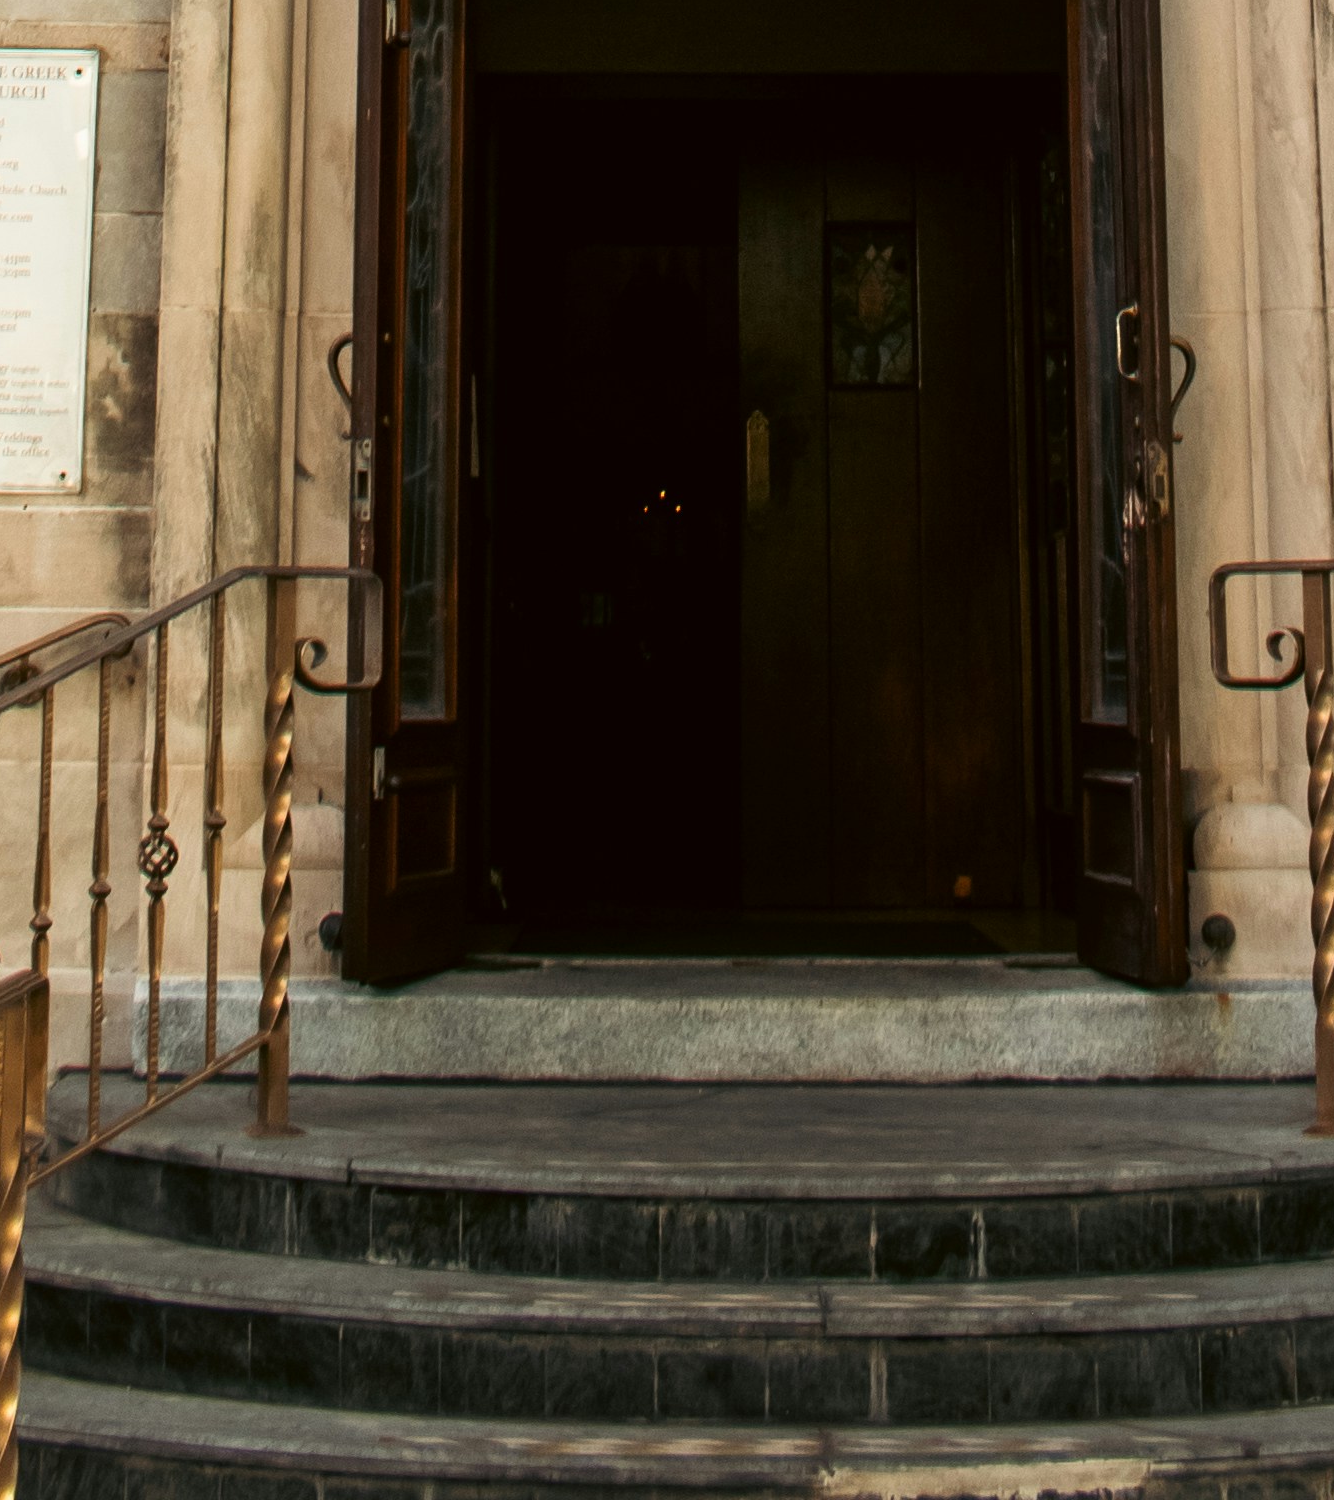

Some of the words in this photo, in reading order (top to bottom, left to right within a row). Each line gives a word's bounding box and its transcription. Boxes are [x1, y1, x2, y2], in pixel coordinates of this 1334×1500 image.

[12, 67, 67, 81] GREEK
[29, 185, 67, 196] Church
[1, 447, 17, 458] the
[20, 445, 50, 458] office
